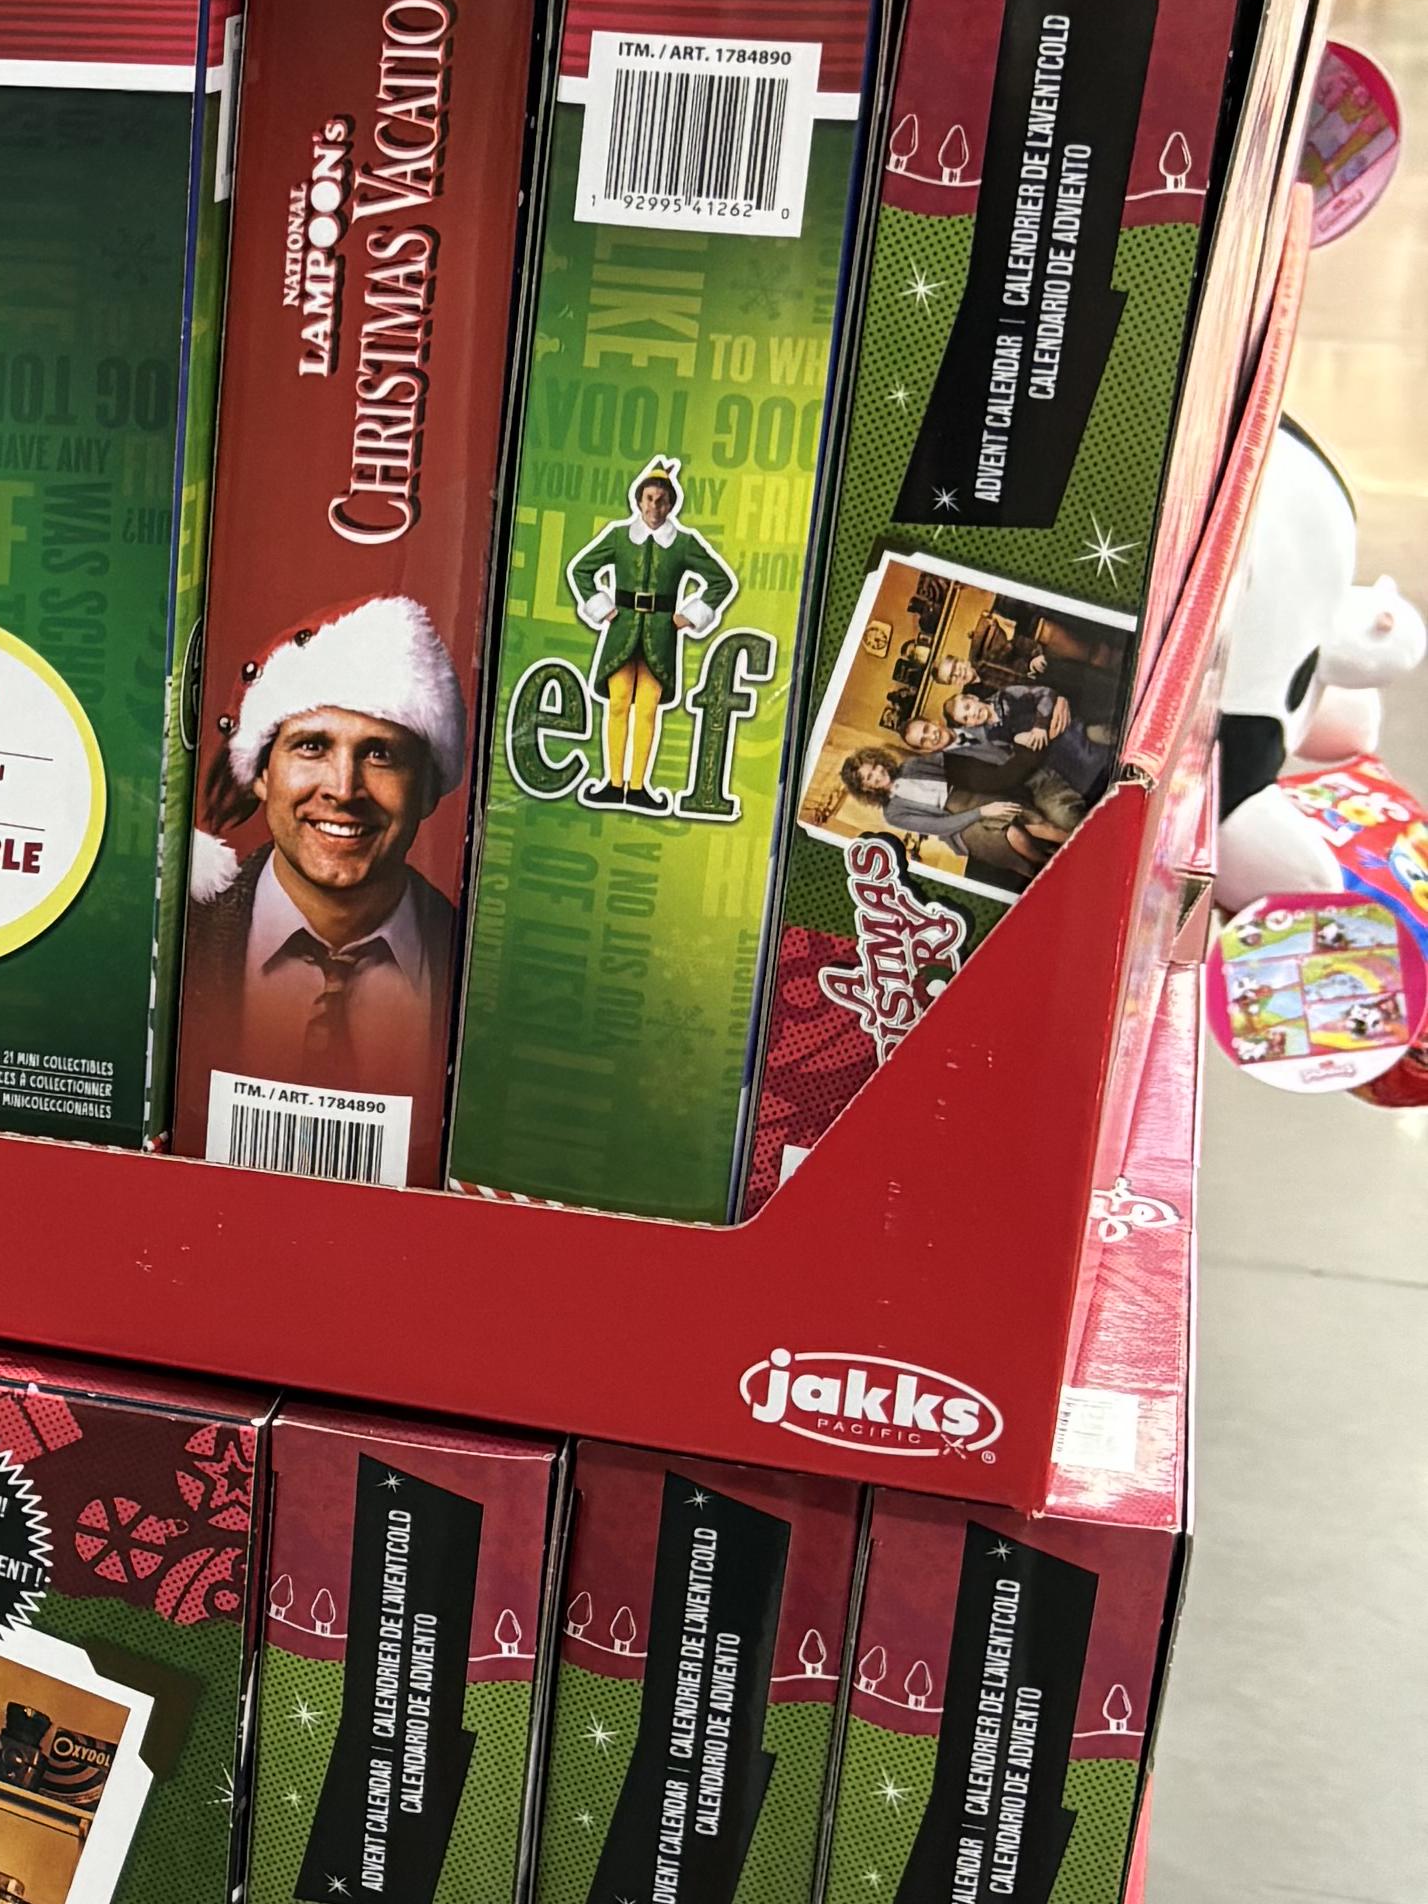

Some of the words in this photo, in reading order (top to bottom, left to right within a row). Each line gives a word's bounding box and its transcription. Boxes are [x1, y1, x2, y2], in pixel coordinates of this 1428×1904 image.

[618, 42, 655, 58] ITM.
[669, 46, 709, 62] ART.
[715, 49, 792, 65] 1784890
[623, 195, 682, 213] 92995
[692, 201, 753, 218] 41262
[1021, 153, 1050, 183] DE
[1052, 144, 1091, 244] ADVIENTO
[283, 181, 309, 308] NATIONAL
[1003, 188, 1044, 307] CALENDRIER
[1045, 246, 1076, 277] DE
[985, 335, 1023, 428] CALENDAR
[1028, 279, 1071, 401] CALENDARIO
[328, 230, 431, 545] CHRISTMAS
[974, 430, 1008, 503] ADVENT
[3, 1049, 14, 1064] 21
[17, 1052, 40, 1067] MINI
[43, 1055, 114, 1076] COLLECTIBLES
[753, 1349, 980, 1437] jakks
